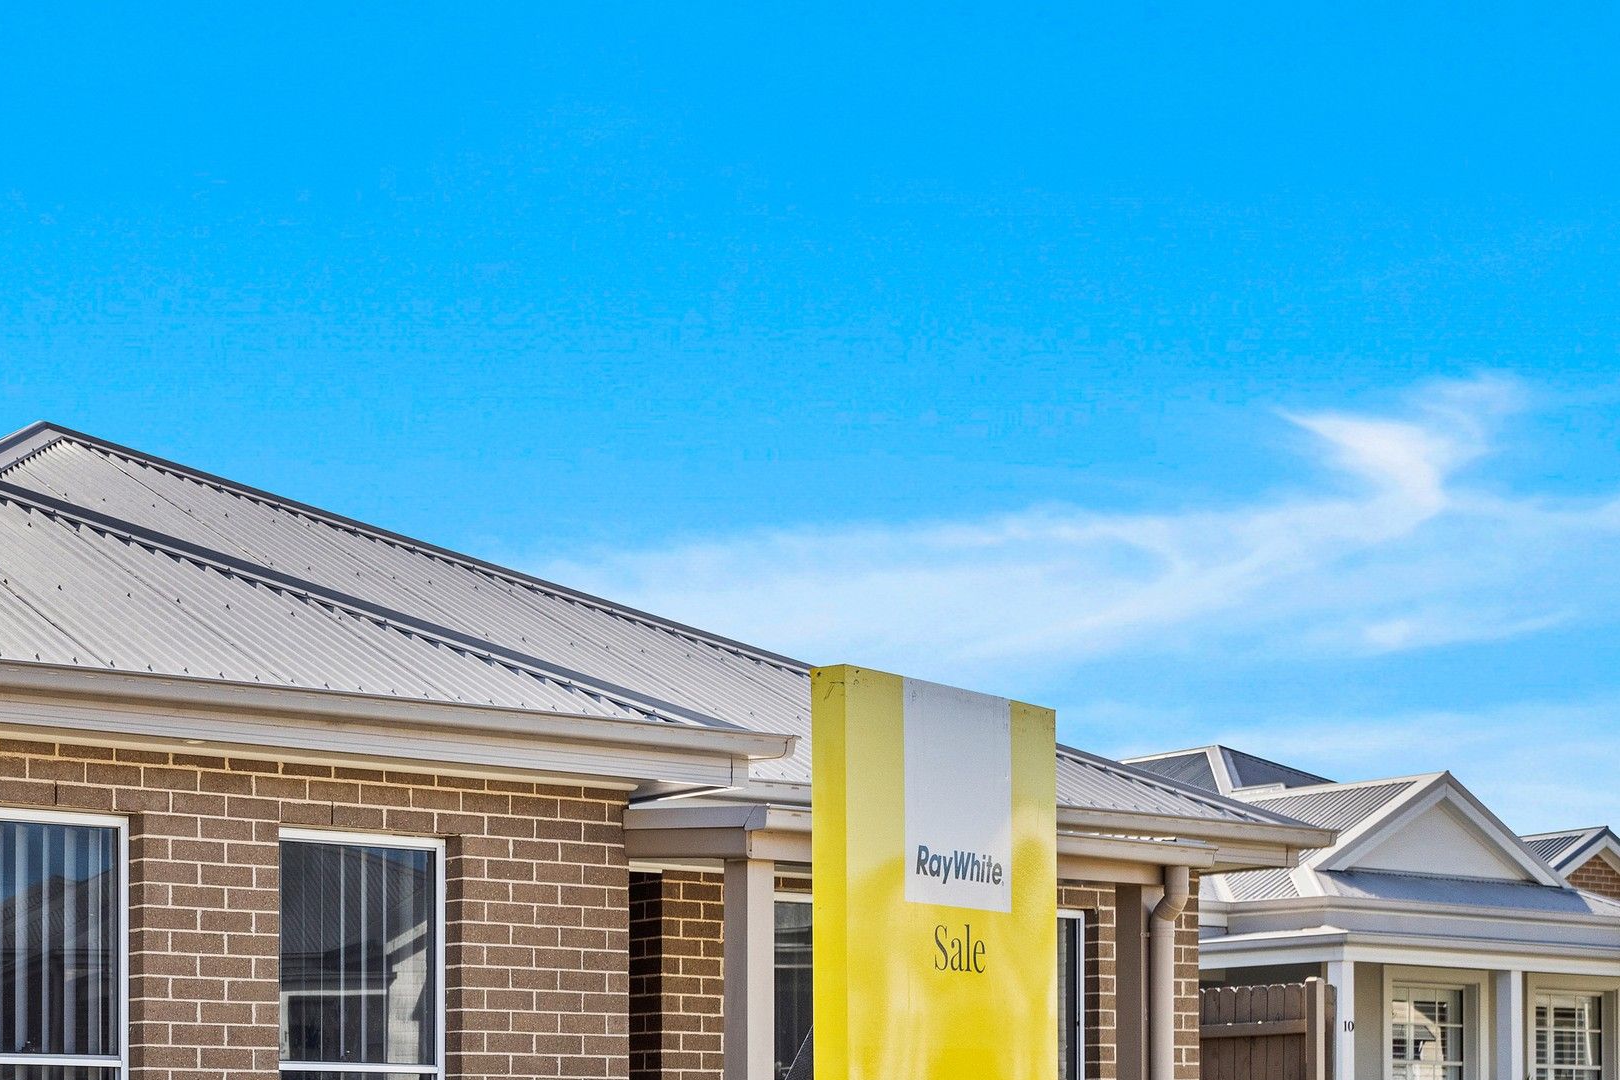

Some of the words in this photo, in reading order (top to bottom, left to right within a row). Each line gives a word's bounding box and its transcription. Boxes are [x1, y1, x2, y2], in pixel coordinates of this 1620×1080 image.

[916, 845, 1002, 885] RayWhite
[934, 924, 986, 974] Sale
[1343, 1020, 1355, 1032] 10
